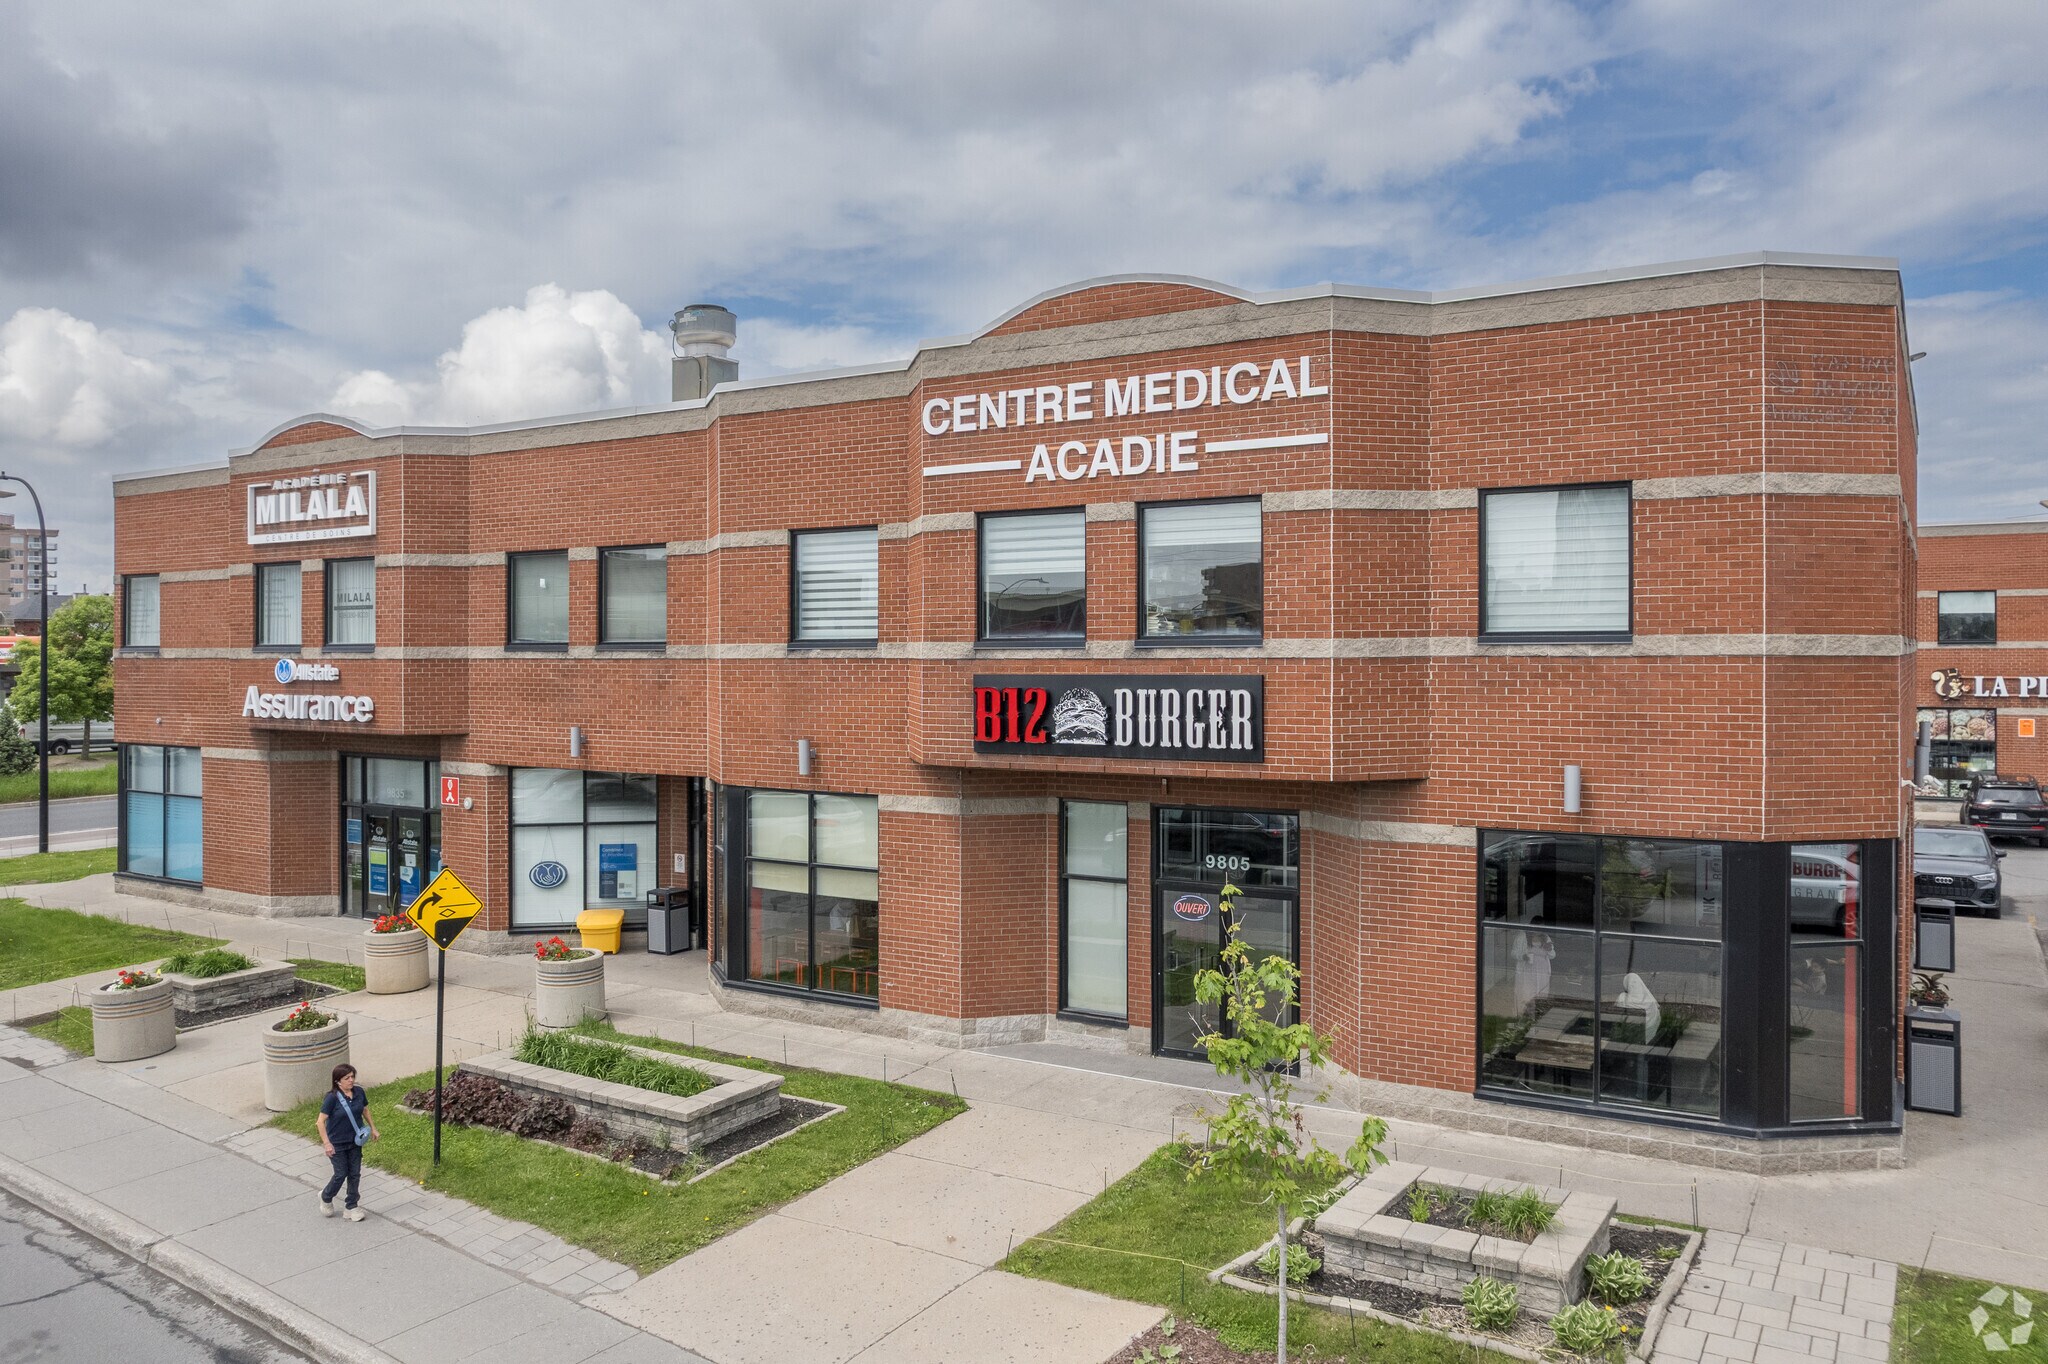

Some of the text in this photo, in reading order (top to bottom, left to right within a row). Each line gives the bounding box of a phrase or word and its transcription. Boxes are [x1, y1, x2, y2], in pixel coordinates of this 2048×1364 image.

[922, 355, 1329, 436] CENTRE MEDICAL
[1024, 430, 1199, 483] ACADIE
[256, 485, 368, 525] MILALA
[265, 528, 352, 542] CENTRE DE SOINS
[337, 592, 371, 603] MILALA
[1974, 675, 2010, 697] LA
[242, 685, 374, 722] Assurance
[1113, 688, 1253, 750] BURGER
[387, 788, 405, 798] 9835
[1205, 855, 1250, 871] 9805
[1175, 902, 1208, 915] OUVERT
